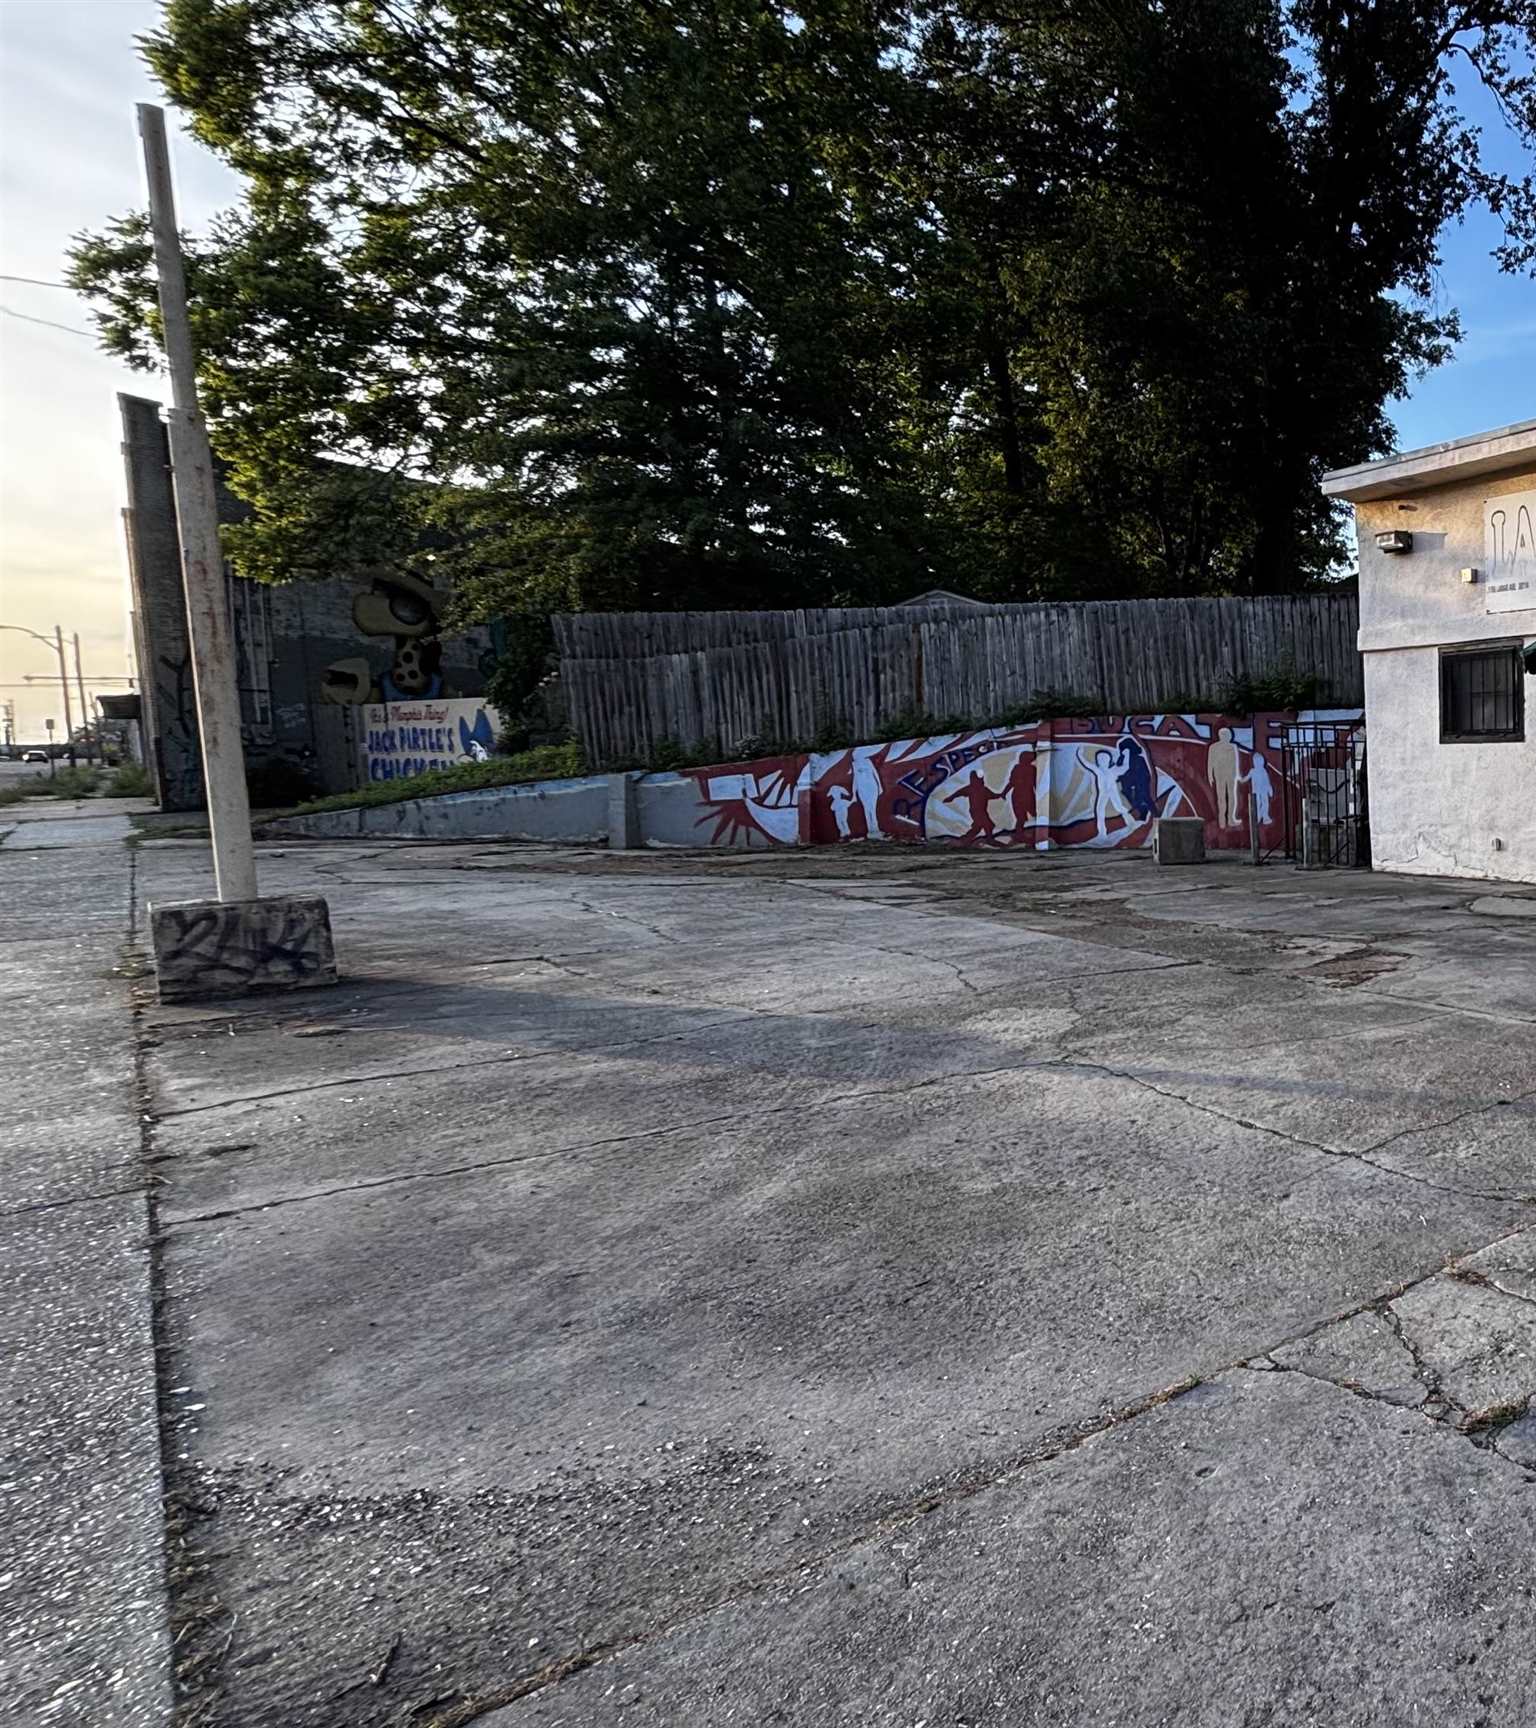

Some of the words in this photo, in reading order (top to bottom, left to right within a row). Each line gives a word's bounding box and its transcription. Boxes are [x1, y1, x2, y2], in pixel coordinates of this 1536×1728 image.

[391, 705, 422, 724] Memphis
[368, 730, 397, 754] JACK
[399, 727, 455, 753] PIRTLE'S
